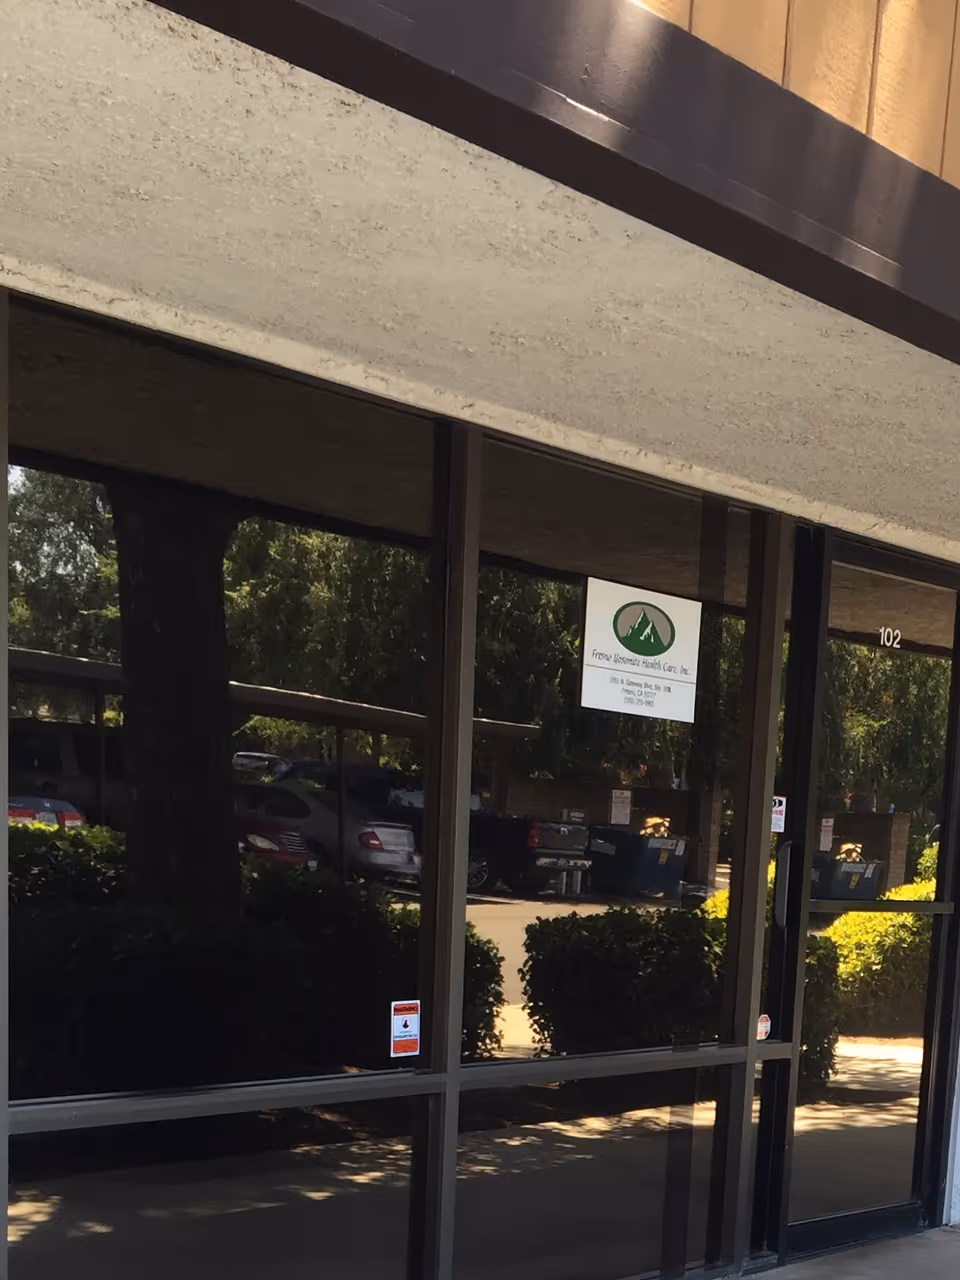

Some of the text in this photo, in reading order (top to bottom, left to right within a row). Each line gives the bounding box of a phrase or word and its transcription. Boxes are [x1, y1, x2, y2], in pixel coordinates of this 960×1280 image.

[879, 626, 901, 649] 102
[592, 649, 612, 662] Fresno
[613, 653, 641, 667] Yosemite
[642, 658, 662, 671] Health
[680, 665, 691, 676] Inc.
